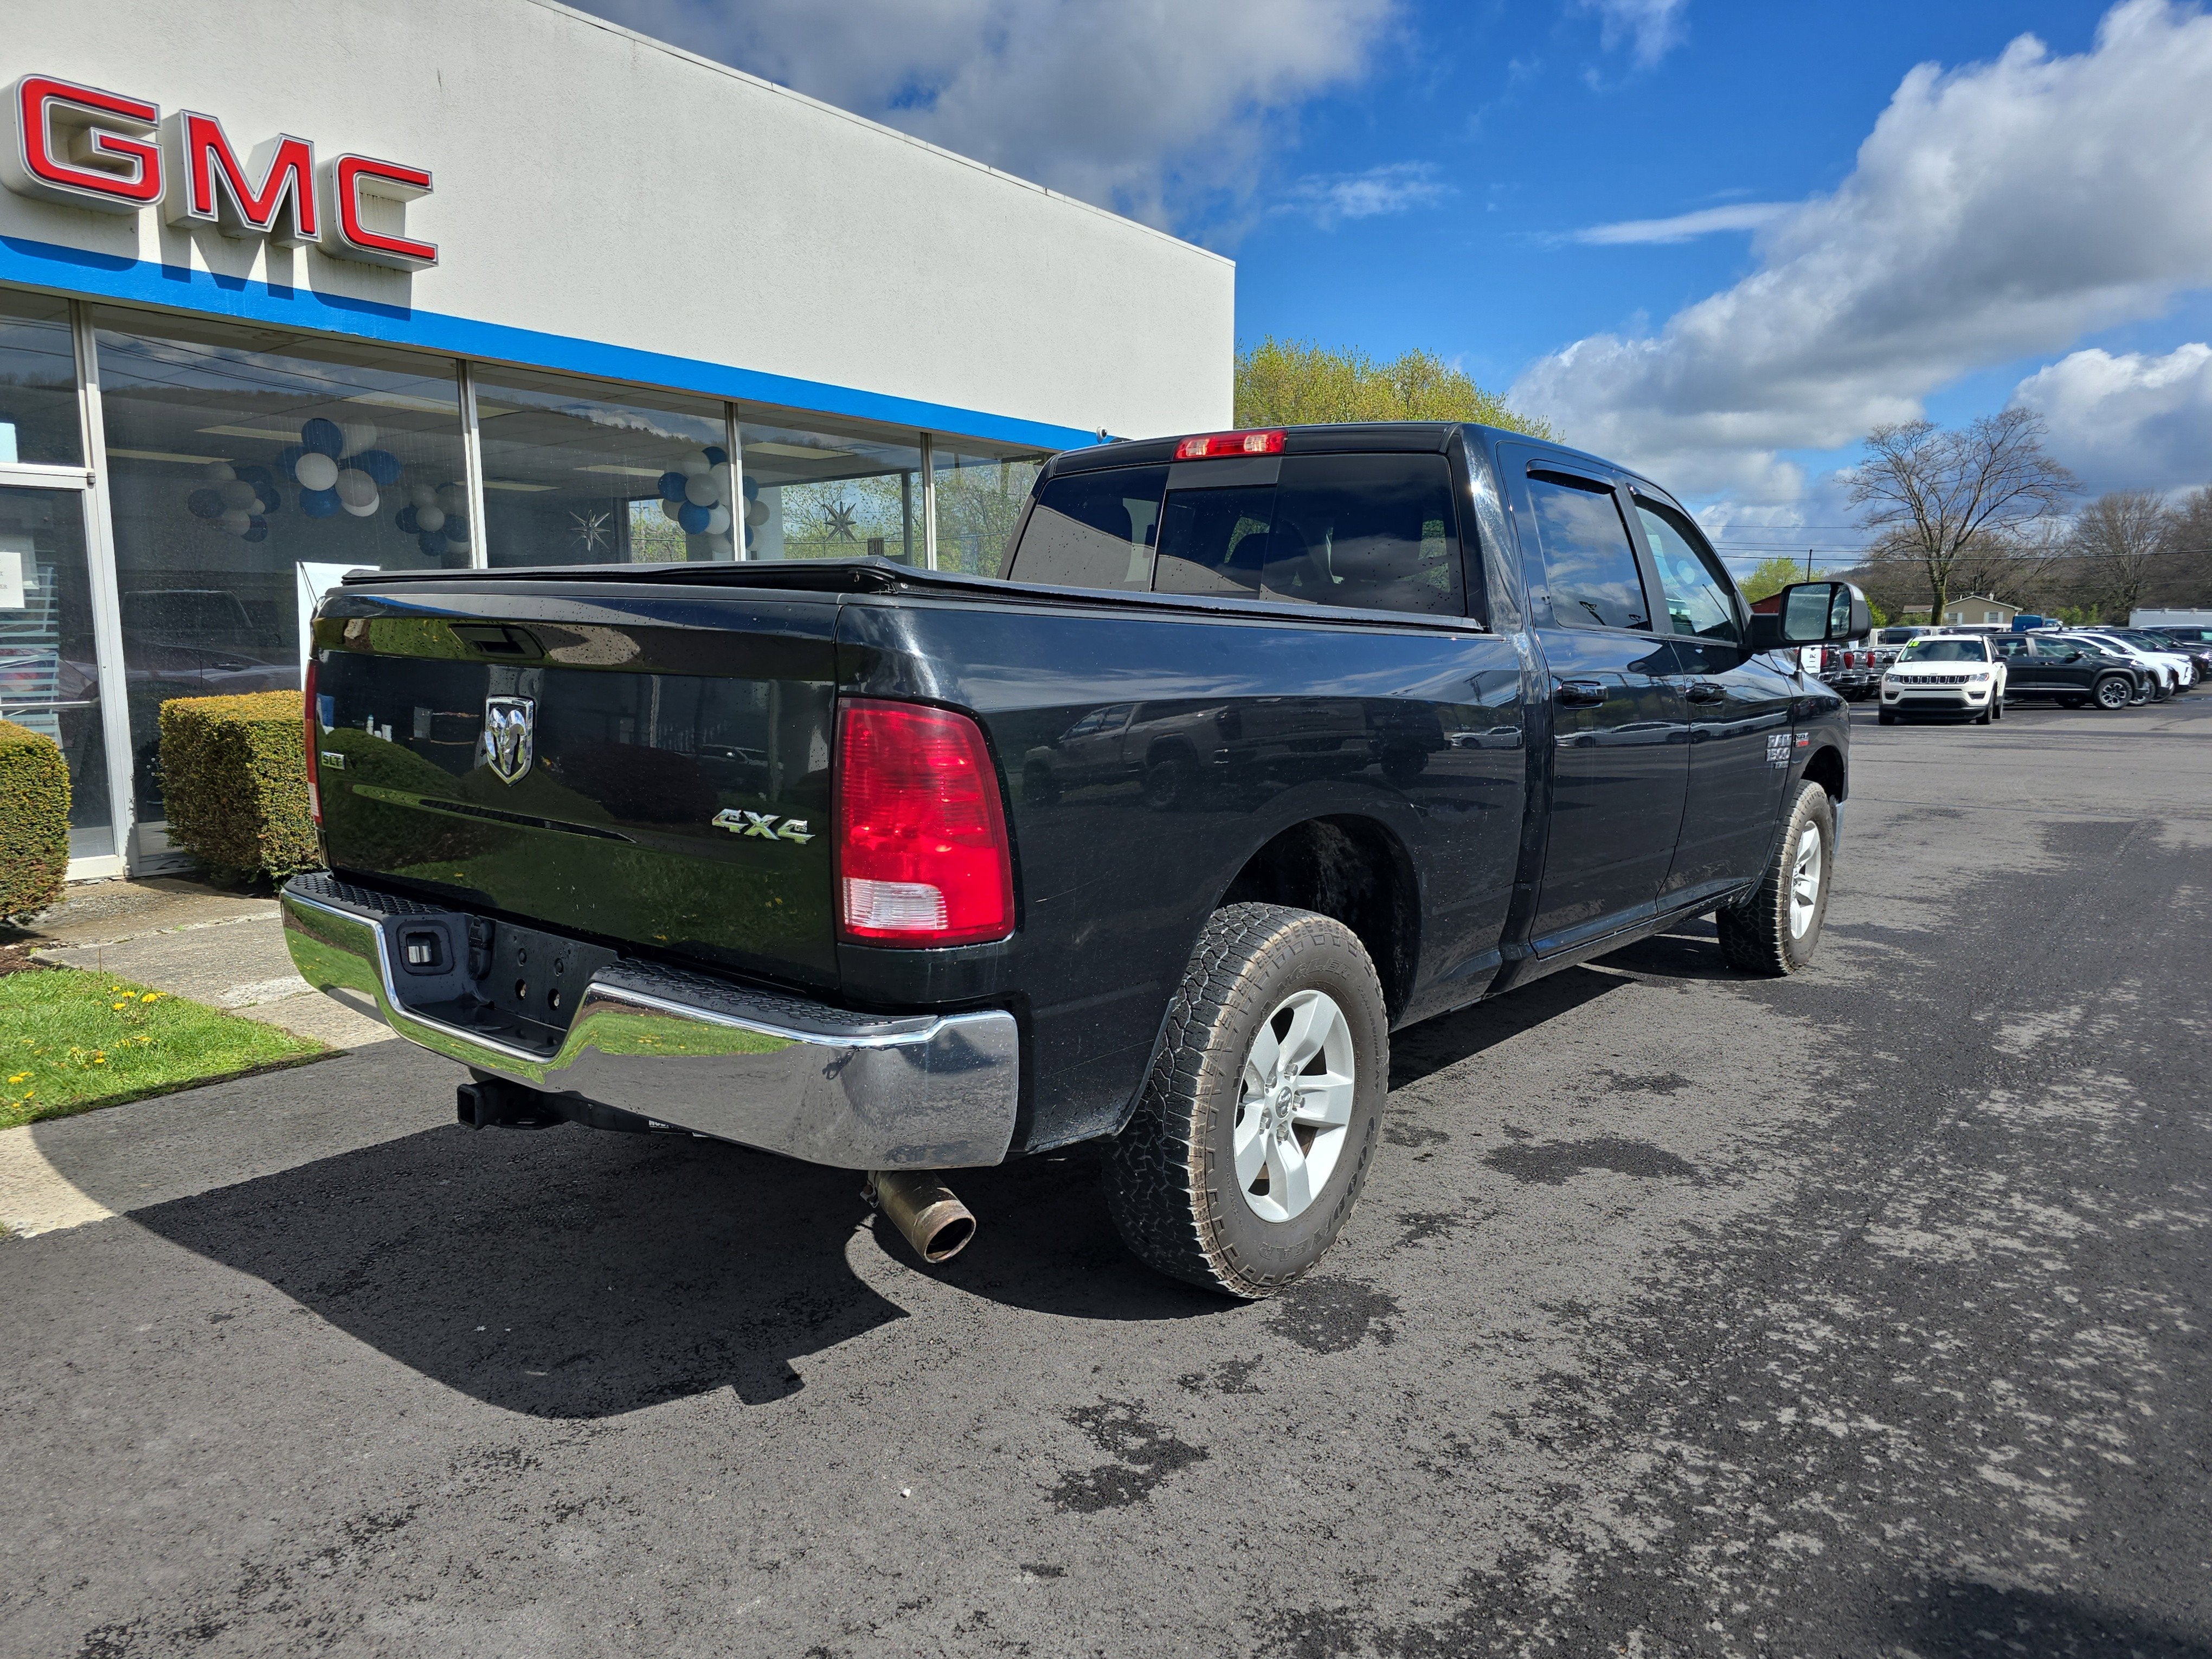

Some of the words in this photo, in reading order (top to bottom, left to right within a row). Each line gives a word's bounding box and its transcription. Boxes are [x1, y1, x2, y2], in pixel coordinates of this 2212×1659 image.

[15, 73, 439, 267] GMC
[322, 753, 343, 768] SLT
[1257, 1115, 1376, 1263] GOODYEAR
